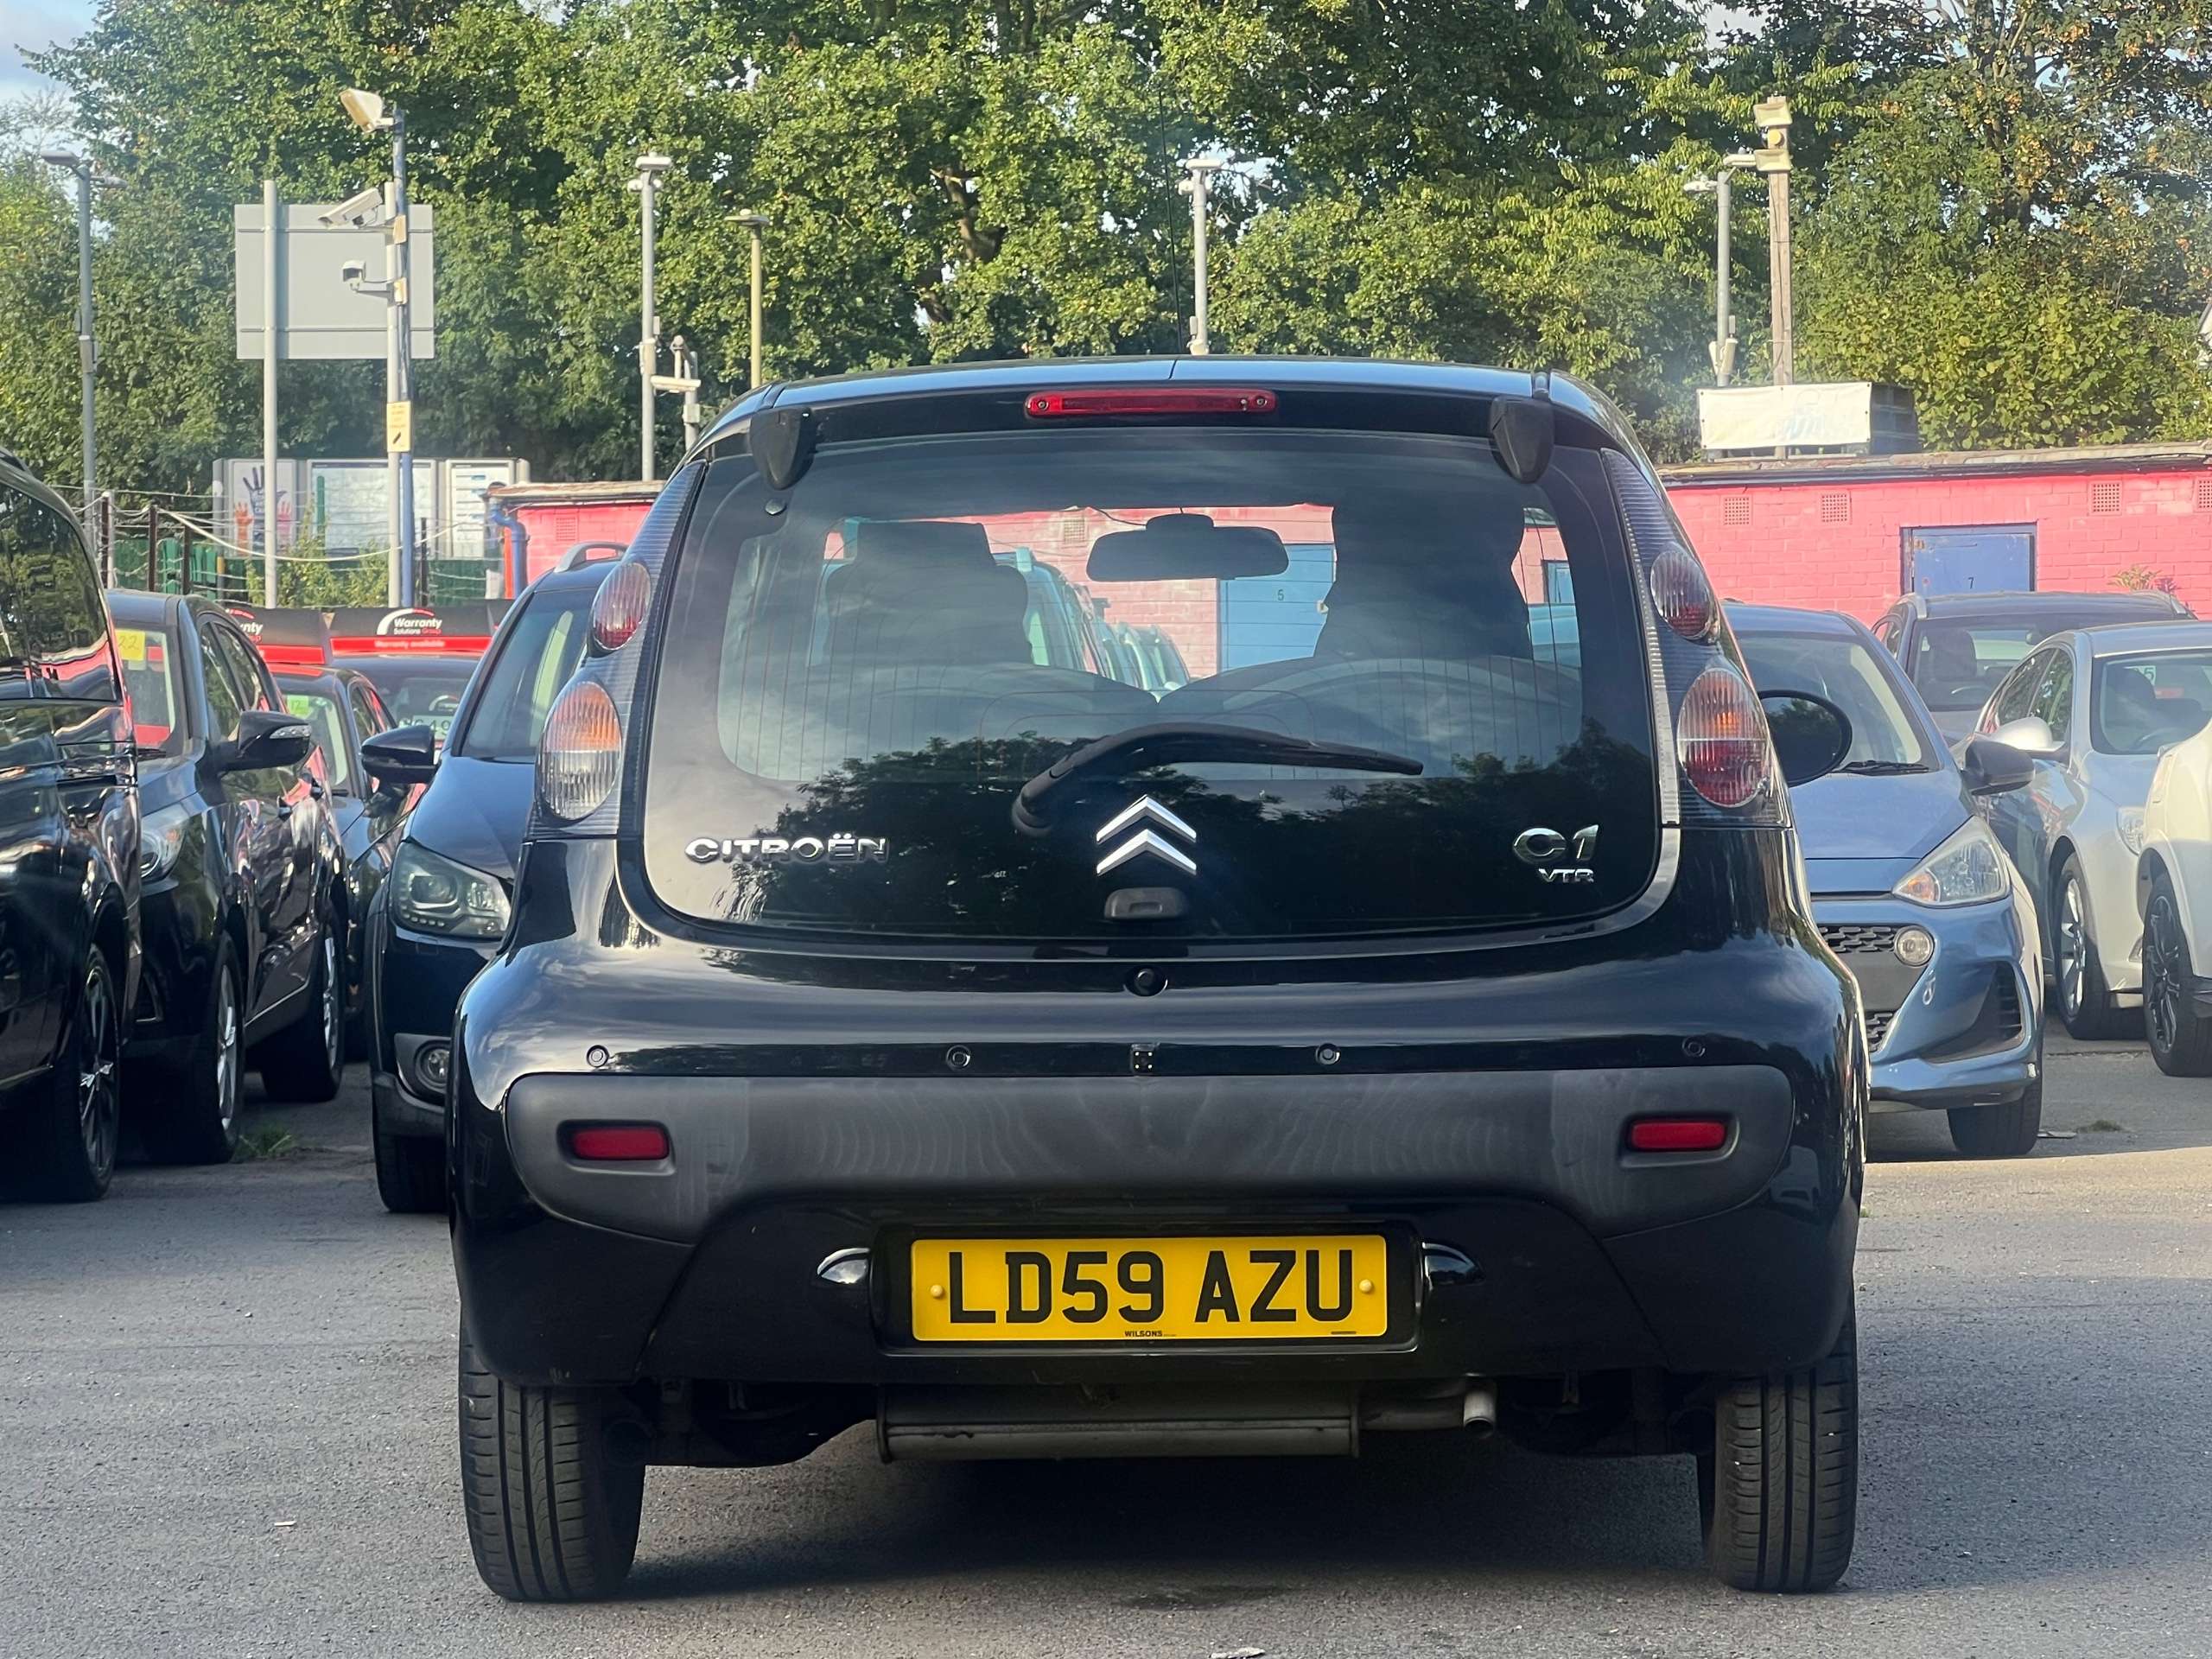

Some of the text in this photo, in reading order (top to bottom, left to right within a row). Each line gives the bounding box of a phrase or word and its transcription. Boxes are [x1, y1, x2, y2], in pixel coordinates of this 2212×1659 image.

[1967, 576, 1974, 589] 7
[1277, 588, 1285, 601] 5
[394, 618, 443, 630] Warranty
[684, 832, 887, 863] CITROËN
[1513, 824, 1599, 862] C1
[1538, 868, 1595, 883] VTR
[948, 1249, 1353, 1325] LD59 AZU
